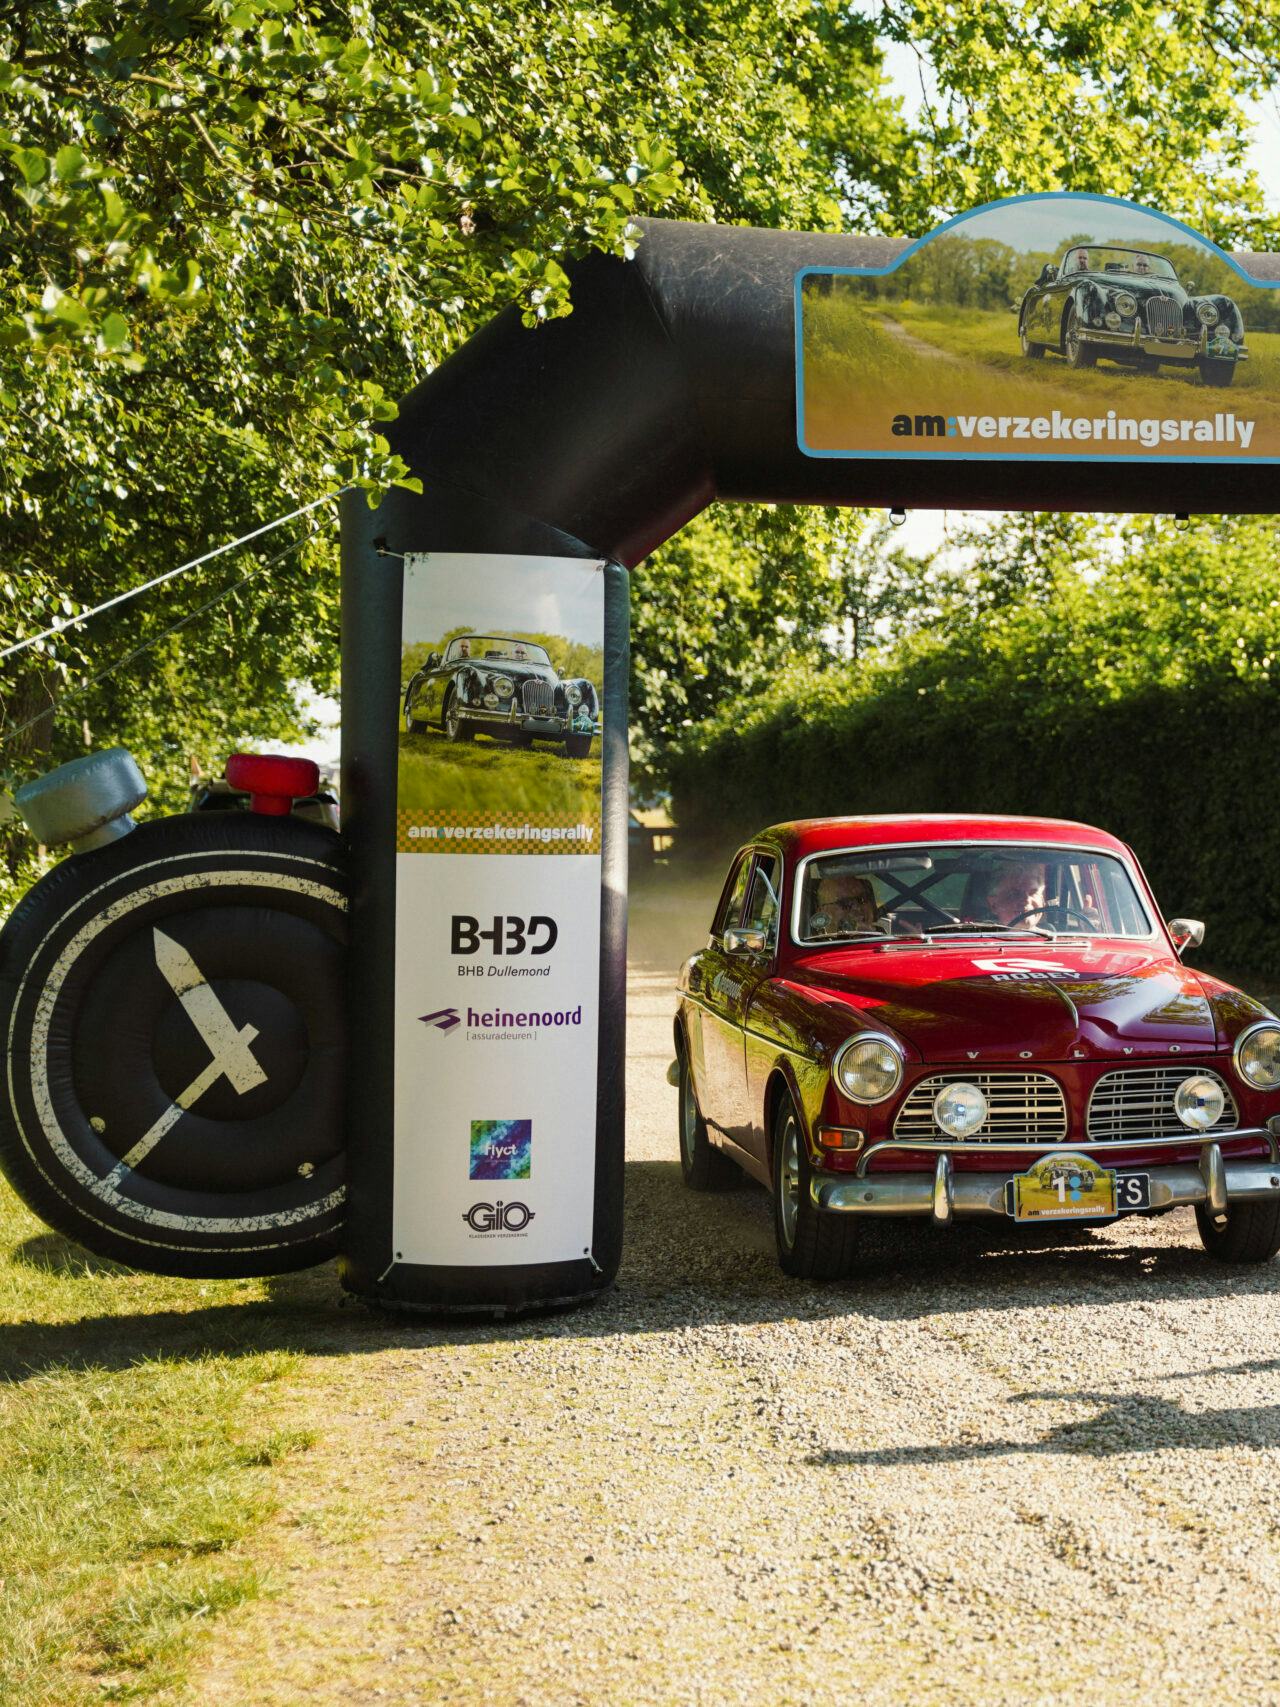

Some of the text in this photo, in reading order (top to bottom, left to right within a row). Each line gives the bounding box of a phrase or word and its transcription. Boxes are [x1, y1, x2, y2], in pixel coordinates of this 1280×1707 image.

[891, 410, 1255, 448] am:verzekeringsrally
[457, 965, 551, 977] BHB Dullemond
[989, 972, 1082, 982] ROBEY
[467, 1005, 582, 1027] heinenoord
[966, 1044, 1182, 1060] VOLVO
